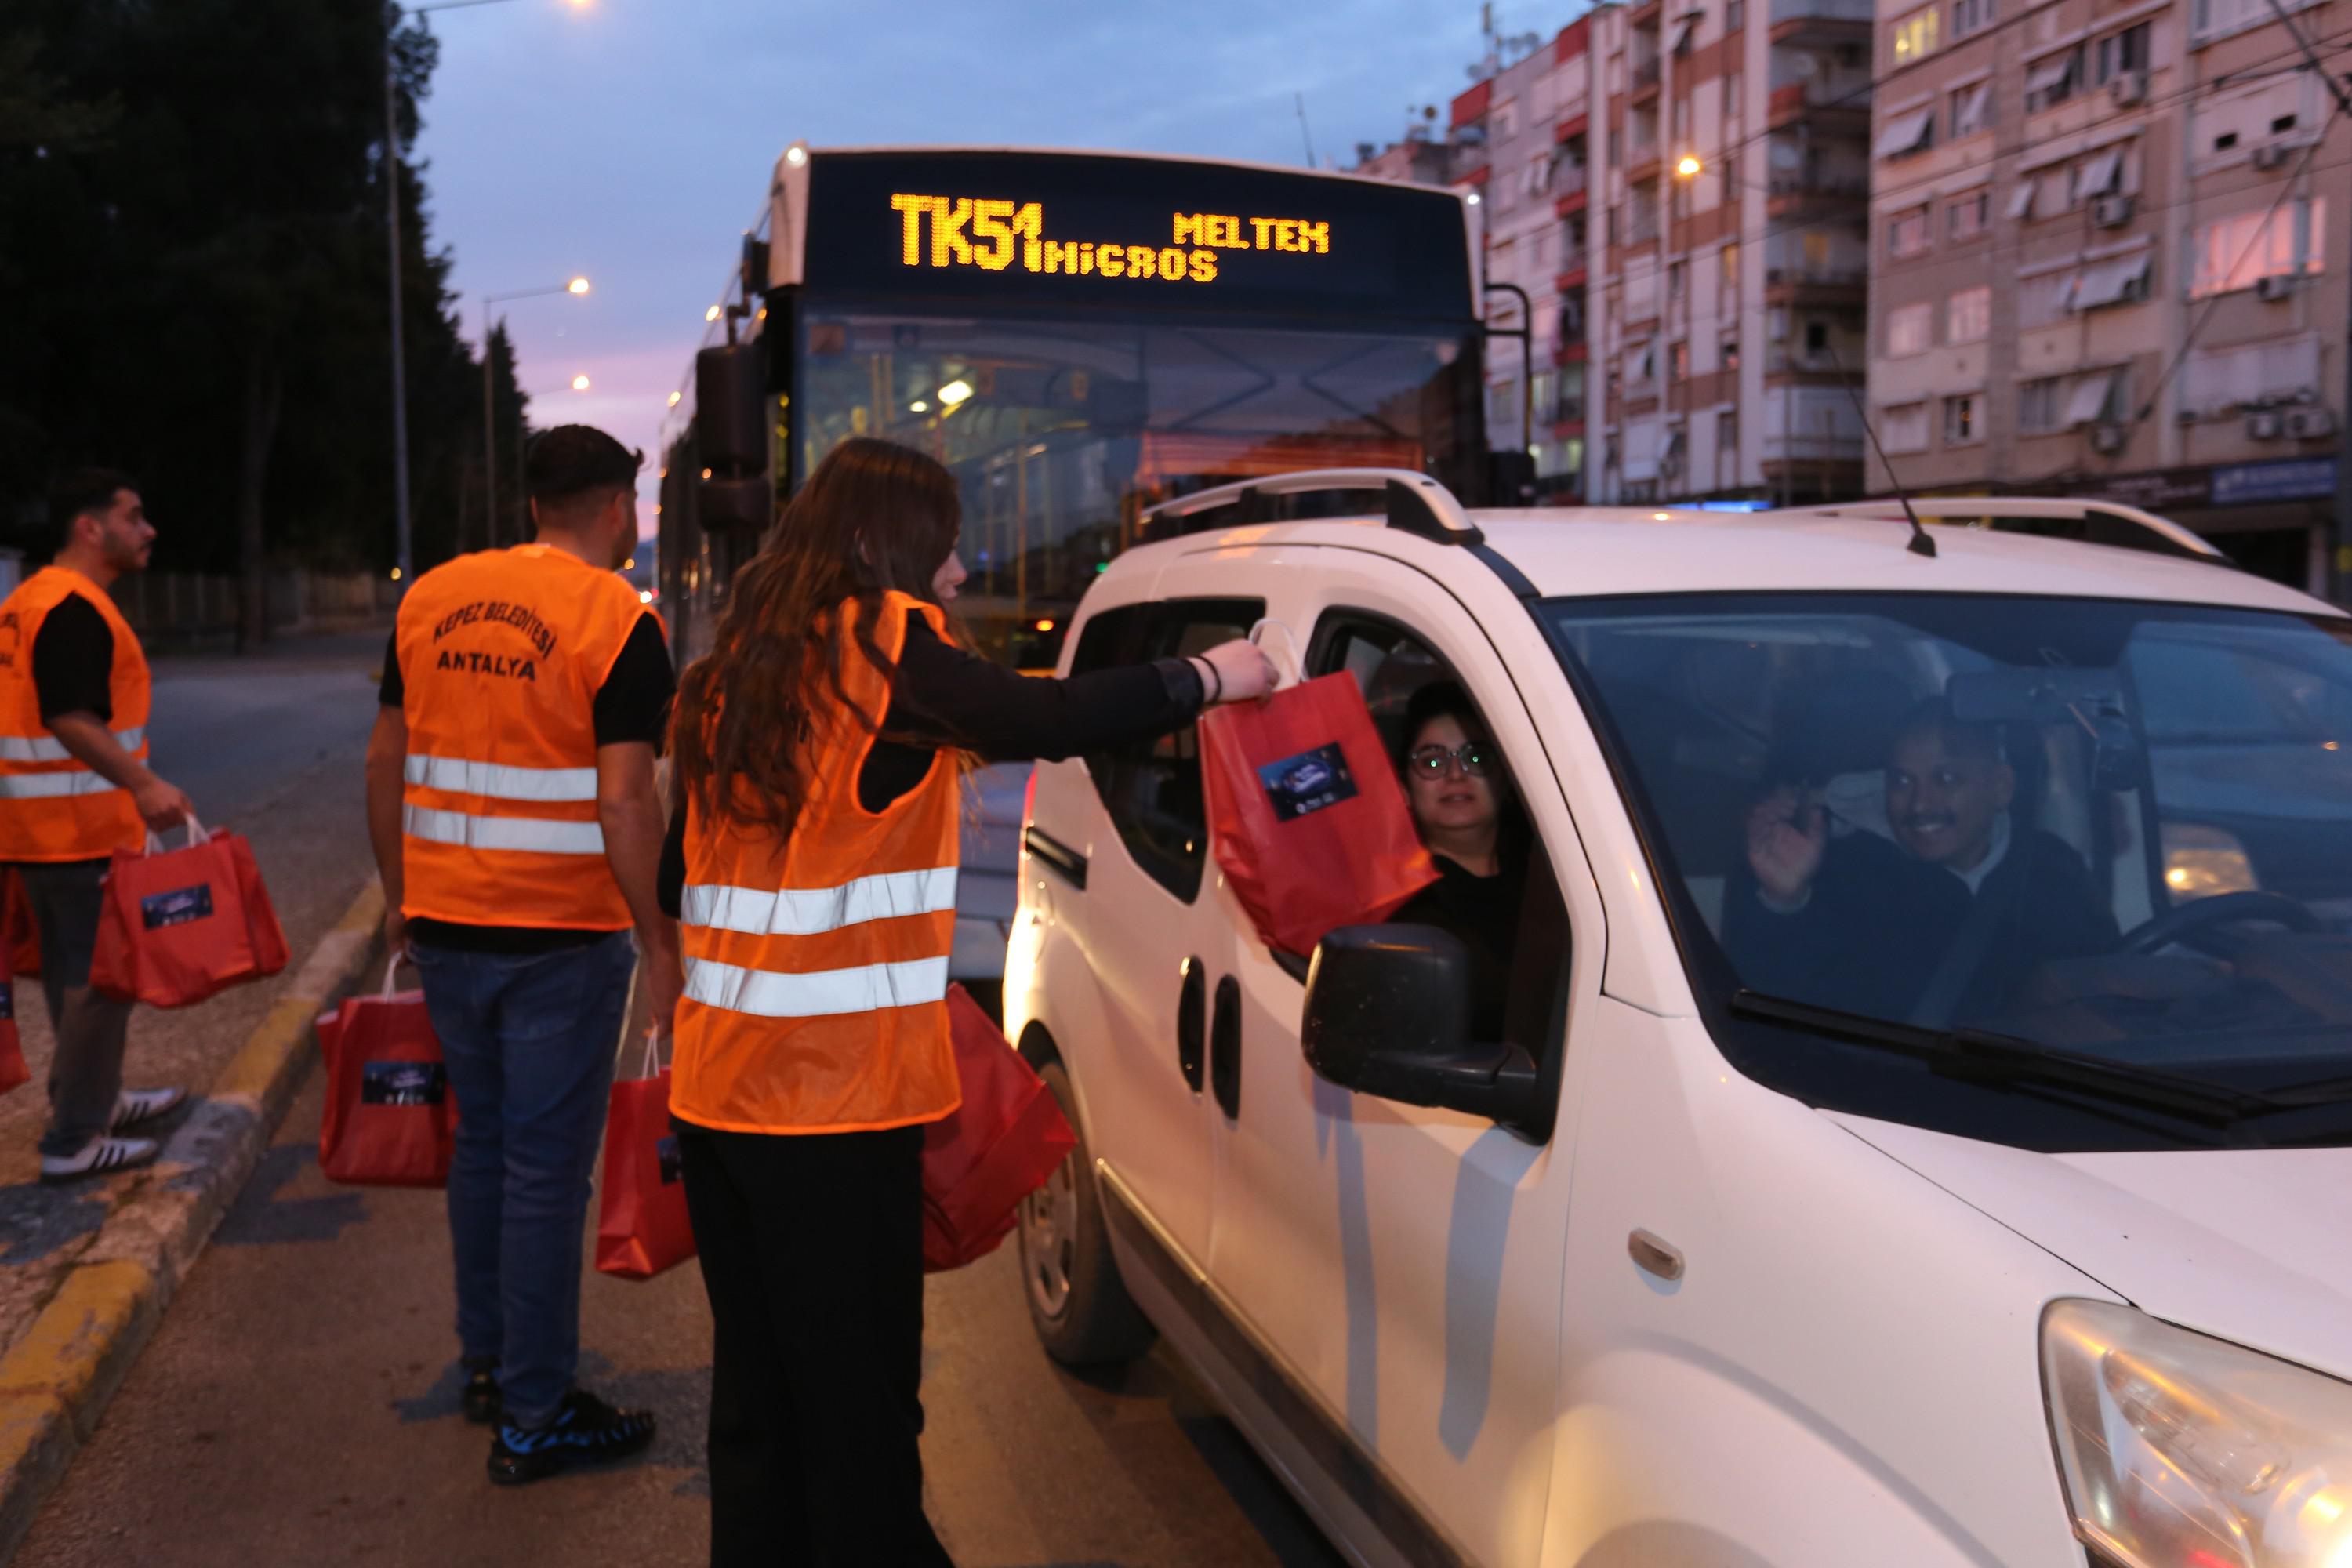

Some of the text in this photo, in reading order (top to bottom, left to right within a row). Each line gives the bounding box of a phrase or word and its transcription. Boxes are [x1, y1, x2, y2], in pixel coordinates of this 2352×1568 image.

[891, 194, 1042, 273] TK51
[1174, 212, 1329, 253] MELTEM
[433, 601, 484, 645] KEPEZ
[437, 650, 536, 682] ANTALYA
